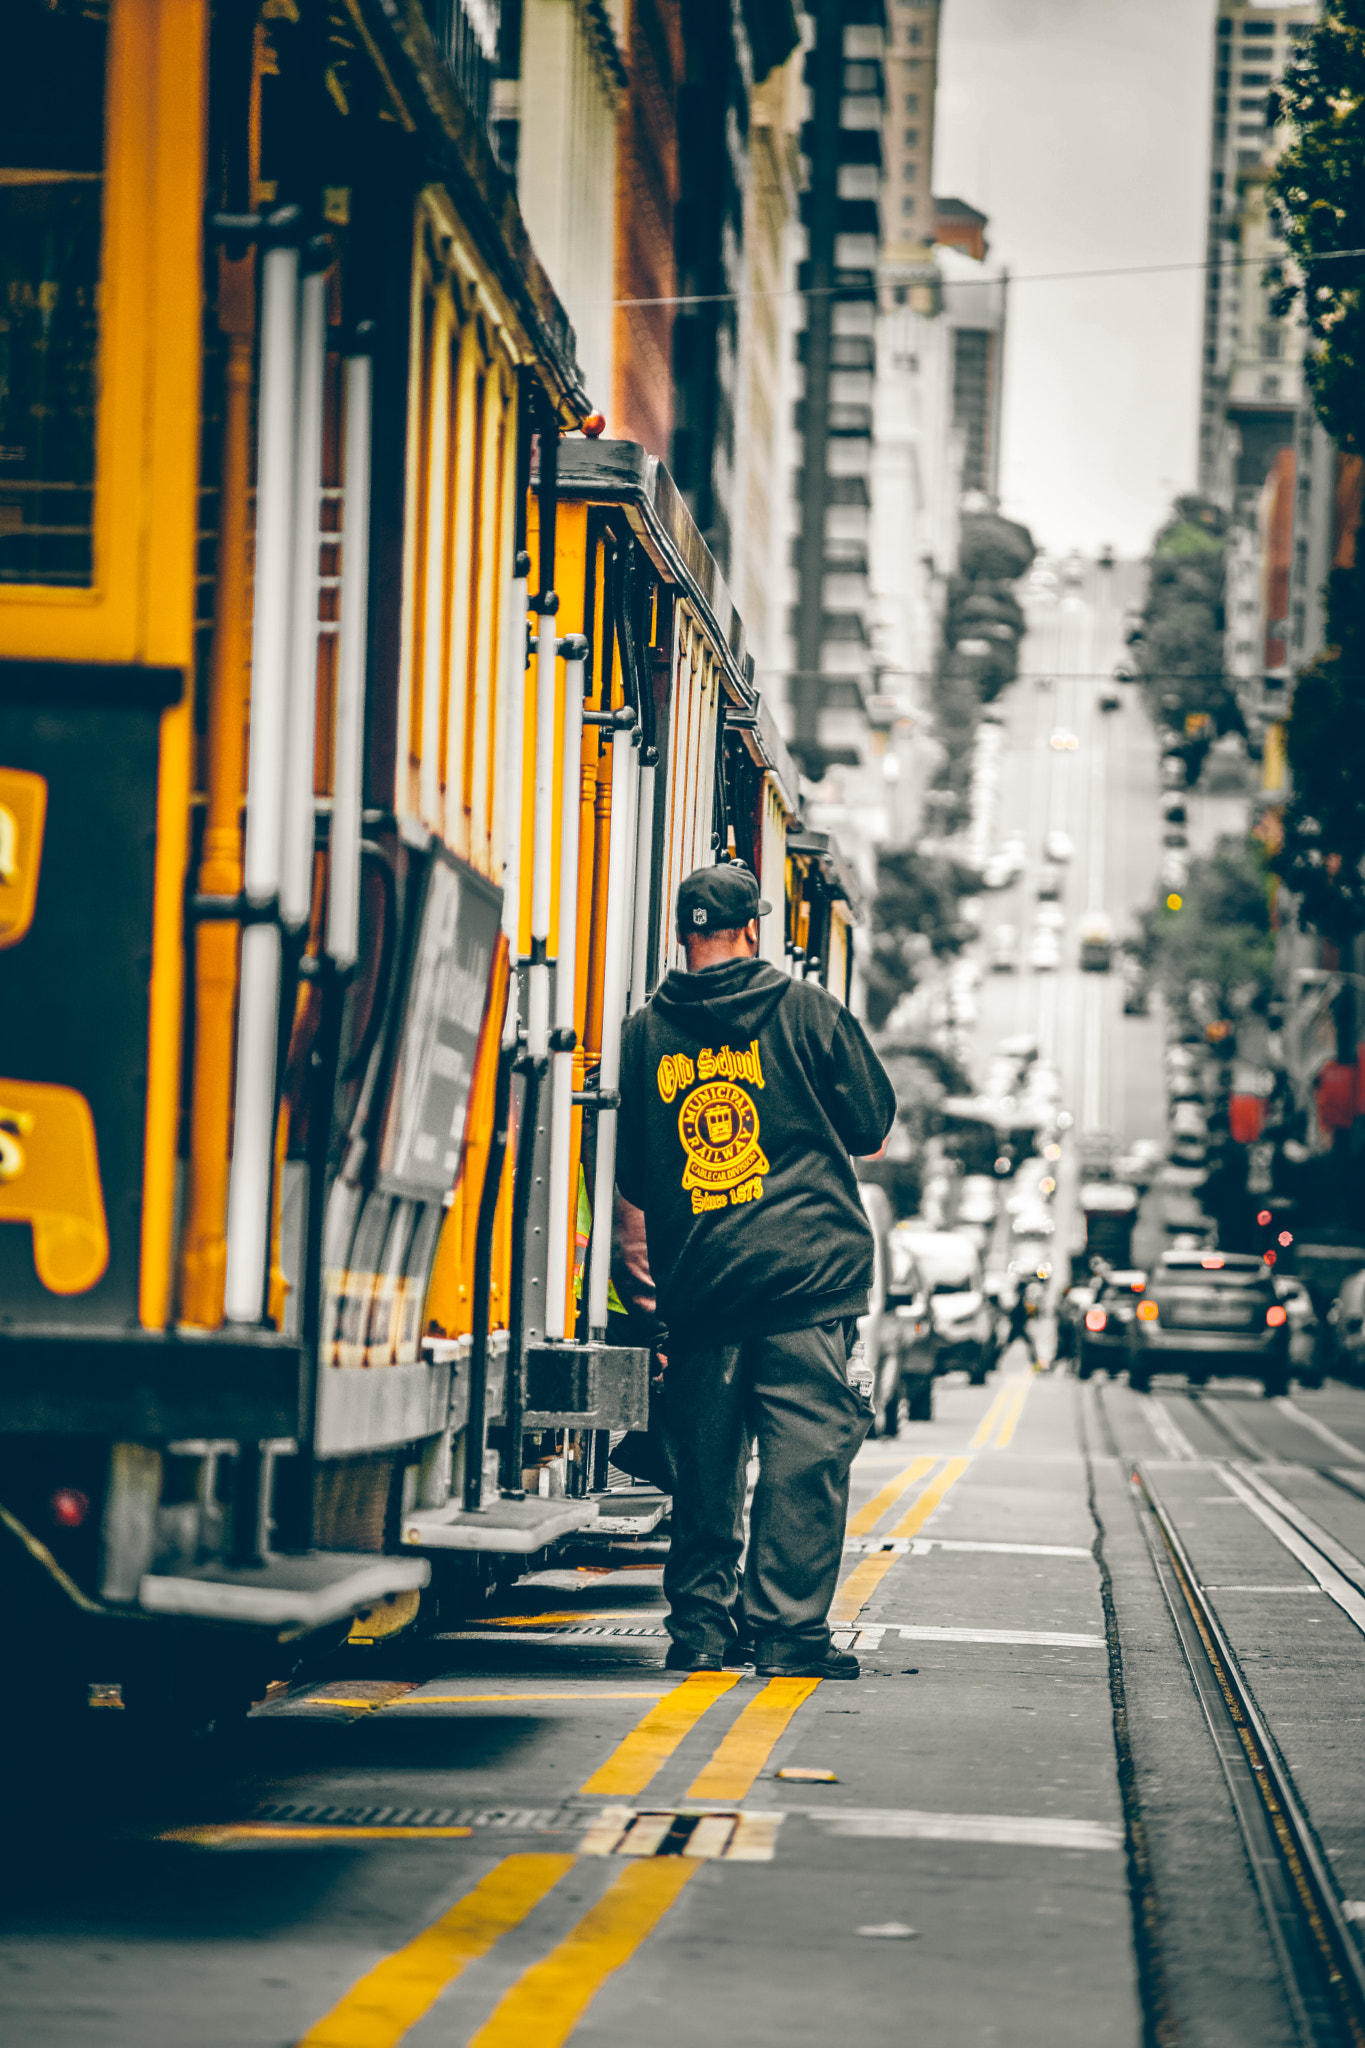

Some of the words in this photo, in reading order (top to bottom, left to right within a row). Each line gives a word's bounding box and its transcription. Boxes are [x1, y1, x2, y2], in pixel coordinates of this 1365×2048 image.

[657, 1053, 695, 1103] Old
[697, 1039, 765, 1089] School
[684, 1087, 750, 1123] MUNICIPAL
[687, 1127, 752, 1162] RAILWAY
[691, 1163, 712, 1180] CABLE
[712, 1172, 727, 1181] CAR
[727, 1151, 758, 1179] DIVISION
[691, 1187, 728, 1214] Since
[729, 1176, 763, 1205] 1873
